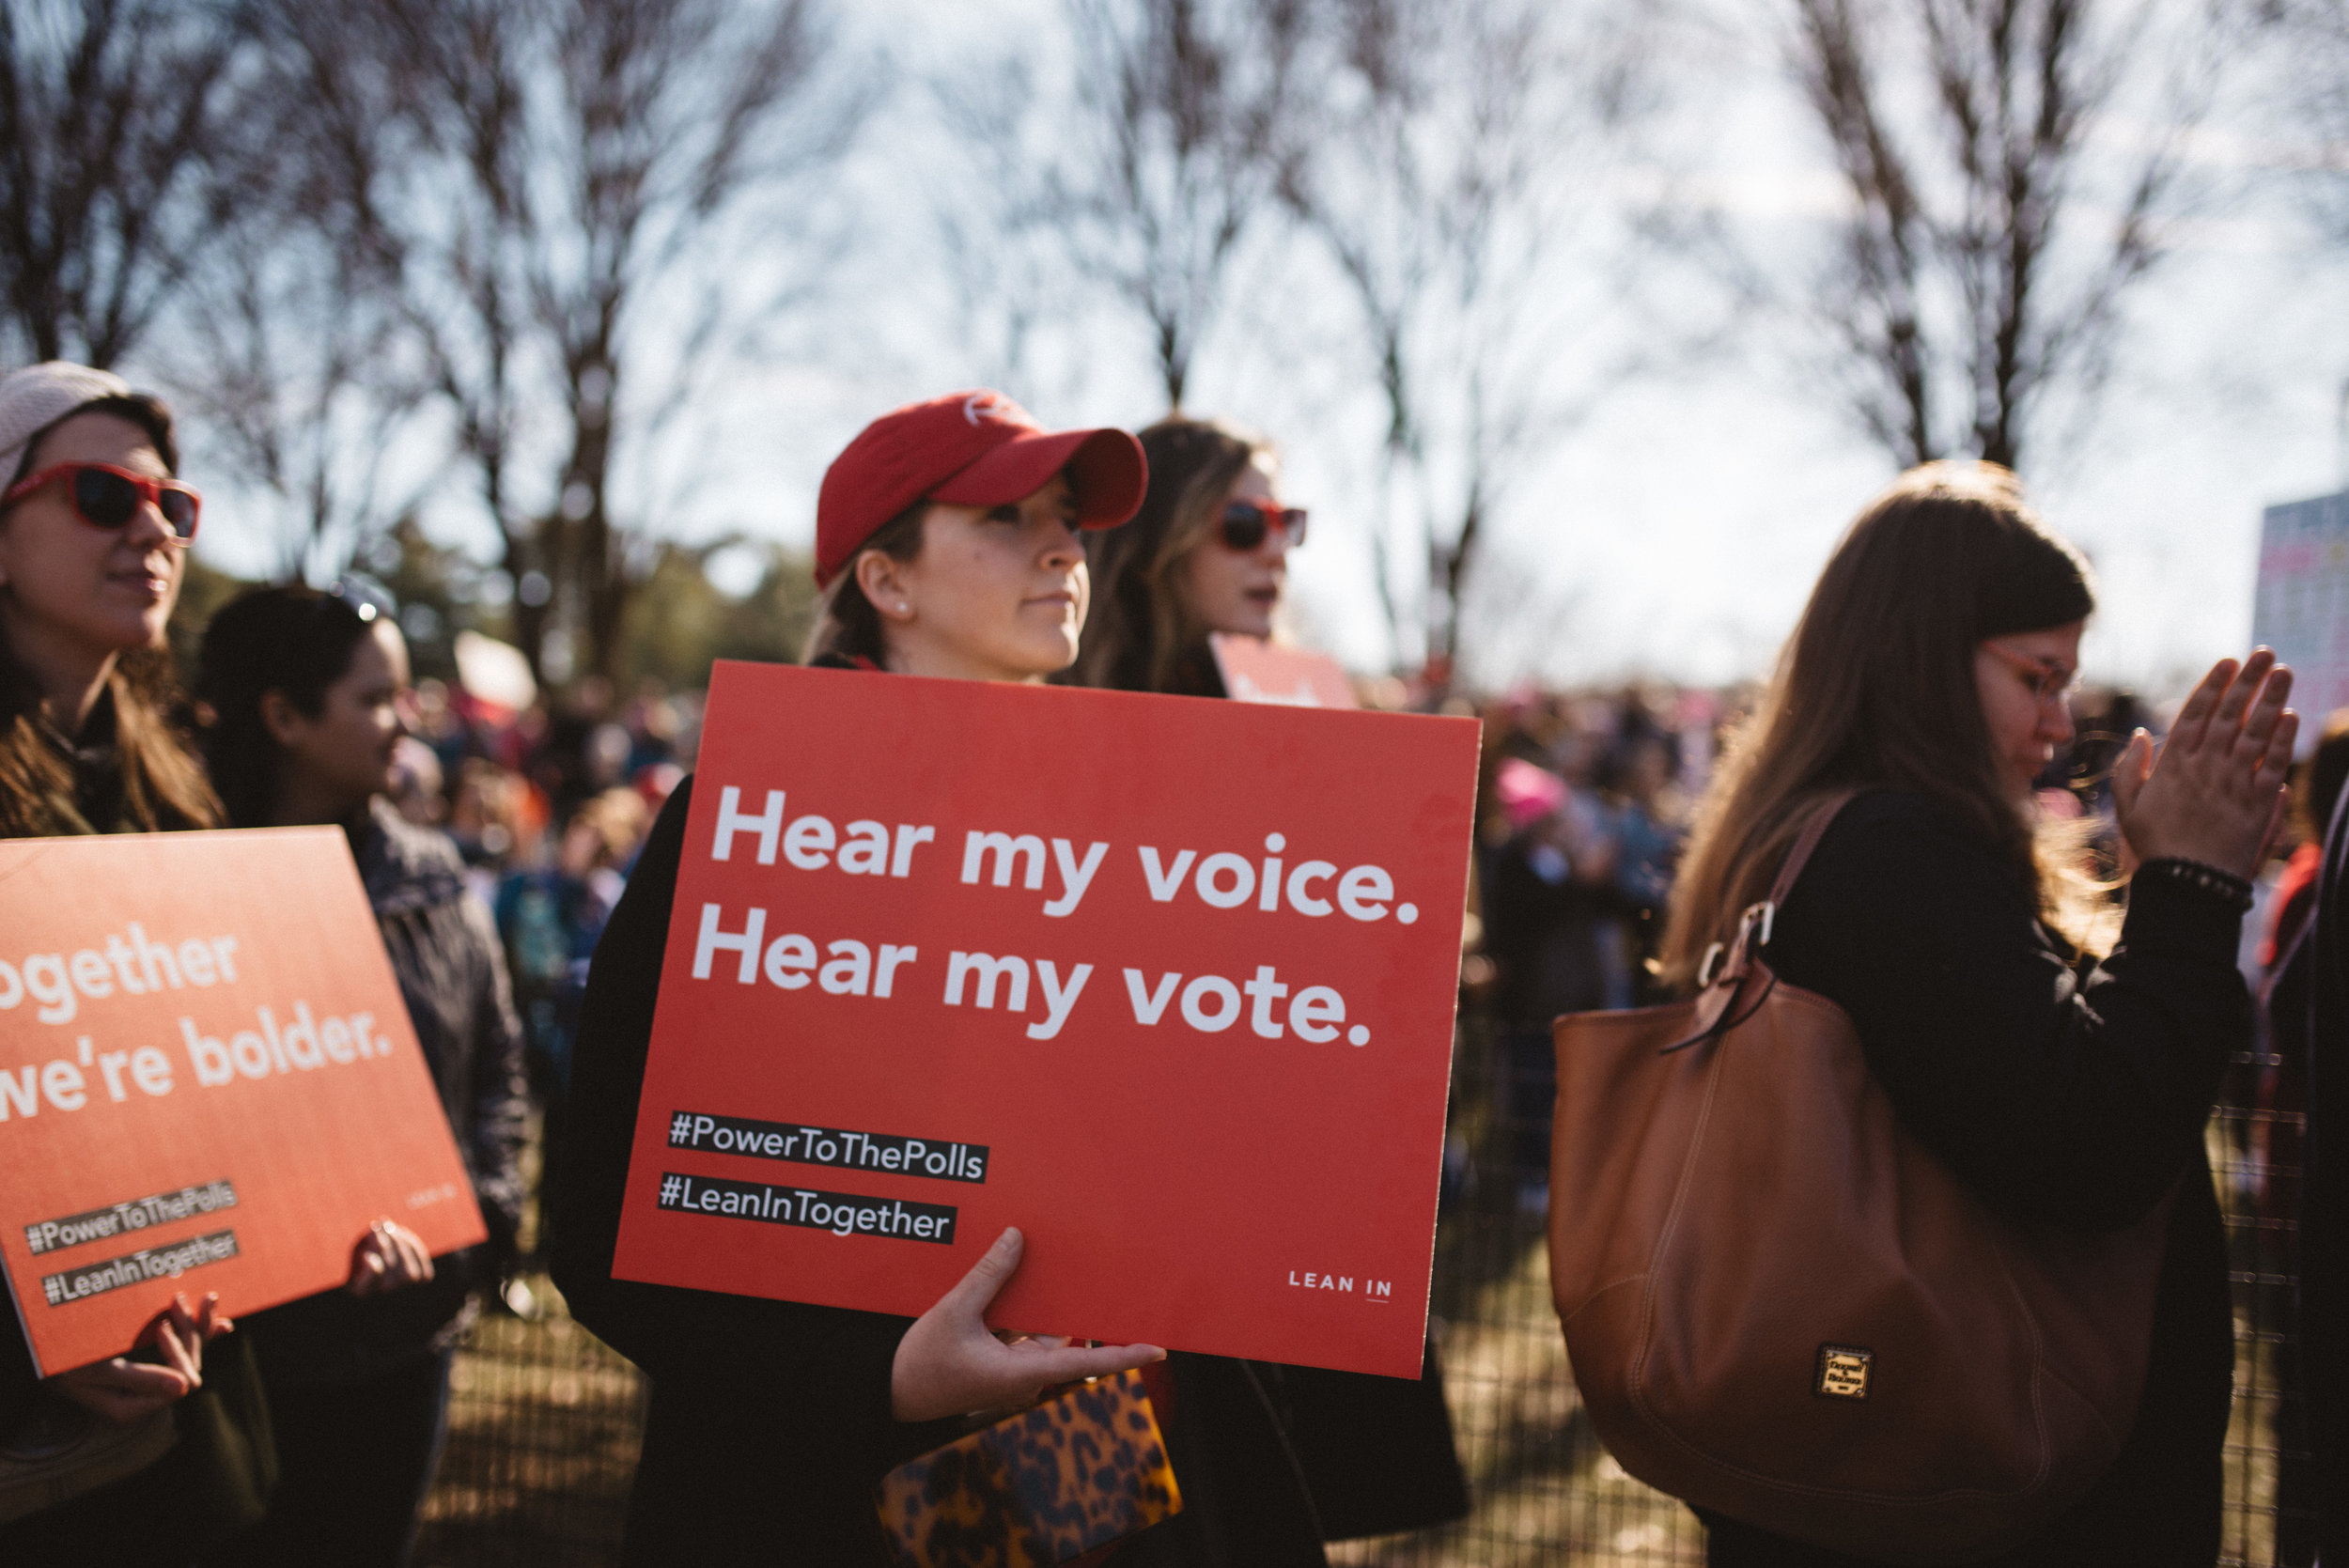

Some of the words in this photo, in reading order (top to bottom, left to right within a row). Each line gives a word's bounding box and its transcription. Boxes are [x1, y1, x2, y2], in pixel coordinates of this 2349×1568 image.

[711, 785, 936, 879] Hear
[960, 831, 1111, 918] my
[1138, 832, 1421, 925] voice.
[692, 903, 918, 999] Hear
[942, 951, 1095, 1041] my
[1123, 966, 1372, 1048] vote.
[179, 1001, 393, 1087] bolder.
[668, 1113, 985, 1181] #PowerToThePolls
[26, 1181, 237, 1255] #PowerToThePolls
[659, 1175, 951, 1238] #LeanInTogether
[44, 1234, 235, 1305] #LeanInTogether
[1288, 1270, 1354, 1293] LEAN
[1366, 1279, 1392, 1297] IN
